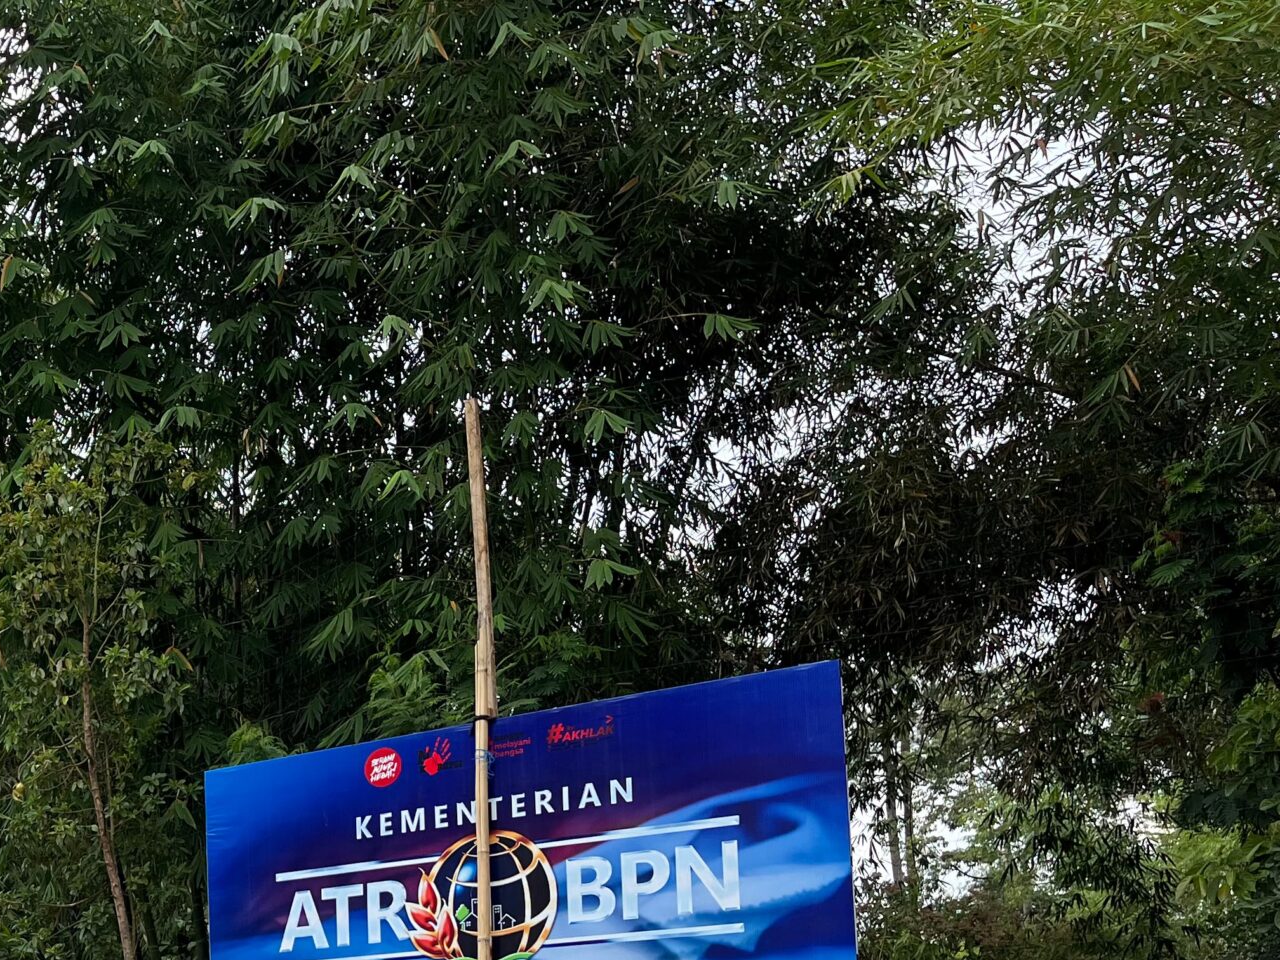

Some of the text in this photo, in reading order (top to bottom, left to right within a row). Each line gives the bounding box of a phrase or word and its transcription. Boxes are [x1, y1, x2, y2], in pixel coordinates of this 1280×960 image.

[355, 777, 634, 840] KEMENTERIAN
[279, 840, 741, 953] ATR BPN
